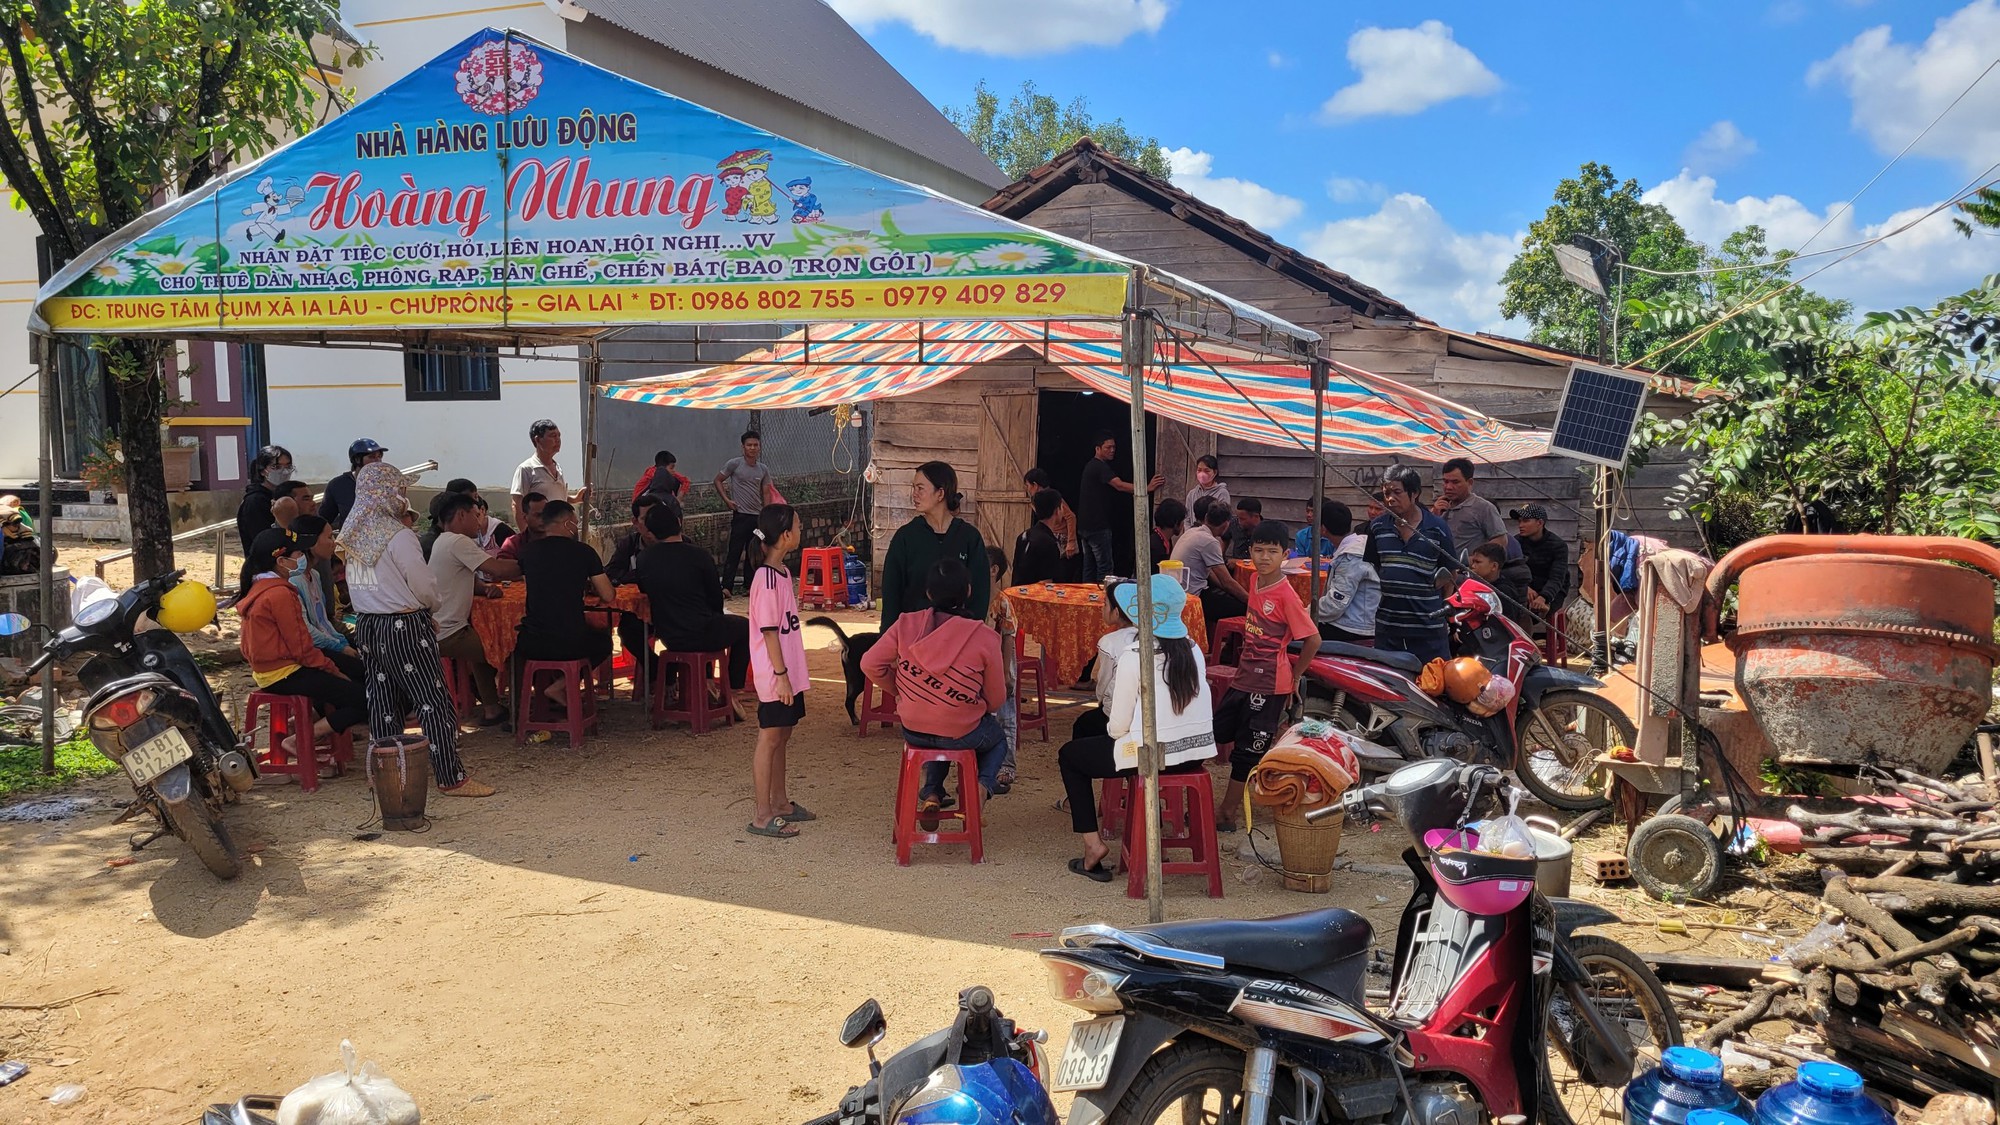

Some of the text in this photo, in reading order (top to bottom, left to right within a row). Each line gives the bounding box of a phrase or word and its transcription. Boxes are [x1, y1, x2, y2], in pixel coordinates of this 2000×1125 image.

[356, 108, 637, 159] NHÀ HÀNG LƯU ĐỘNG
[306, 155, 718, 237] Hoàng Nhung
[240, 246, 290, 266] NHẬN
[296, 246, 334, 267] ĐẶT
[341, 244, 386, 266] TIỆC
[161, 276, 195, 289] CHO
[202, 271, 250, 288] THUÊ
[256, 268, 293, 287] DÀN
[299, 271, 358, 290] NHẠC,
[363, 267, 431, 285] PHÔNG
[438, 268, 485, 288] RẠP,
[492, 261, 535, 281] BÀN
[542, 258, 594, 282] GHẾ,
[603, 259, 665, 277] CHÉN
[736, 259, 782, 275] BAO
[792, 257, 860, 278] TRỌN
[70, 303, 100, 319] ĐC:
[106, 302, 165, 319] TRUNG
[171, 298, 210, 318] TÂM
[215, 301, 262, 321] CỤM
[268, 296, 295, 317] XÃ
[302, 300, 323, 317] IA
[328, 296, 368, 316] LÂU
[390, 292, 514, 315] CHƯPRÔNG
[537, 294, 582, 312] GIA
[589, 293, 622, 312] LAI
[650, 292, 683, 311] ĐT:
[692, 291, 749, 310] 0986
[757, 290, 801, 309] 802
[810, 289, 855, 308] 755
[883, 285, 948, 306] 0979
[957, 283, 1005, 305] 409
[1015, 282, 1066, 304] 829
[781, 611, 800, 634] Je
[899, 655, 924, 677] AY
[131, 733, 173, 765] 81-B1
[135, 743, 187, 781] 912.75
[1249, 980, 1339, 1007] SIRIUS
[1071, 1020, 1114, 1053] 81-T1
[1057, 1053, 1108, 1086] 099.33
